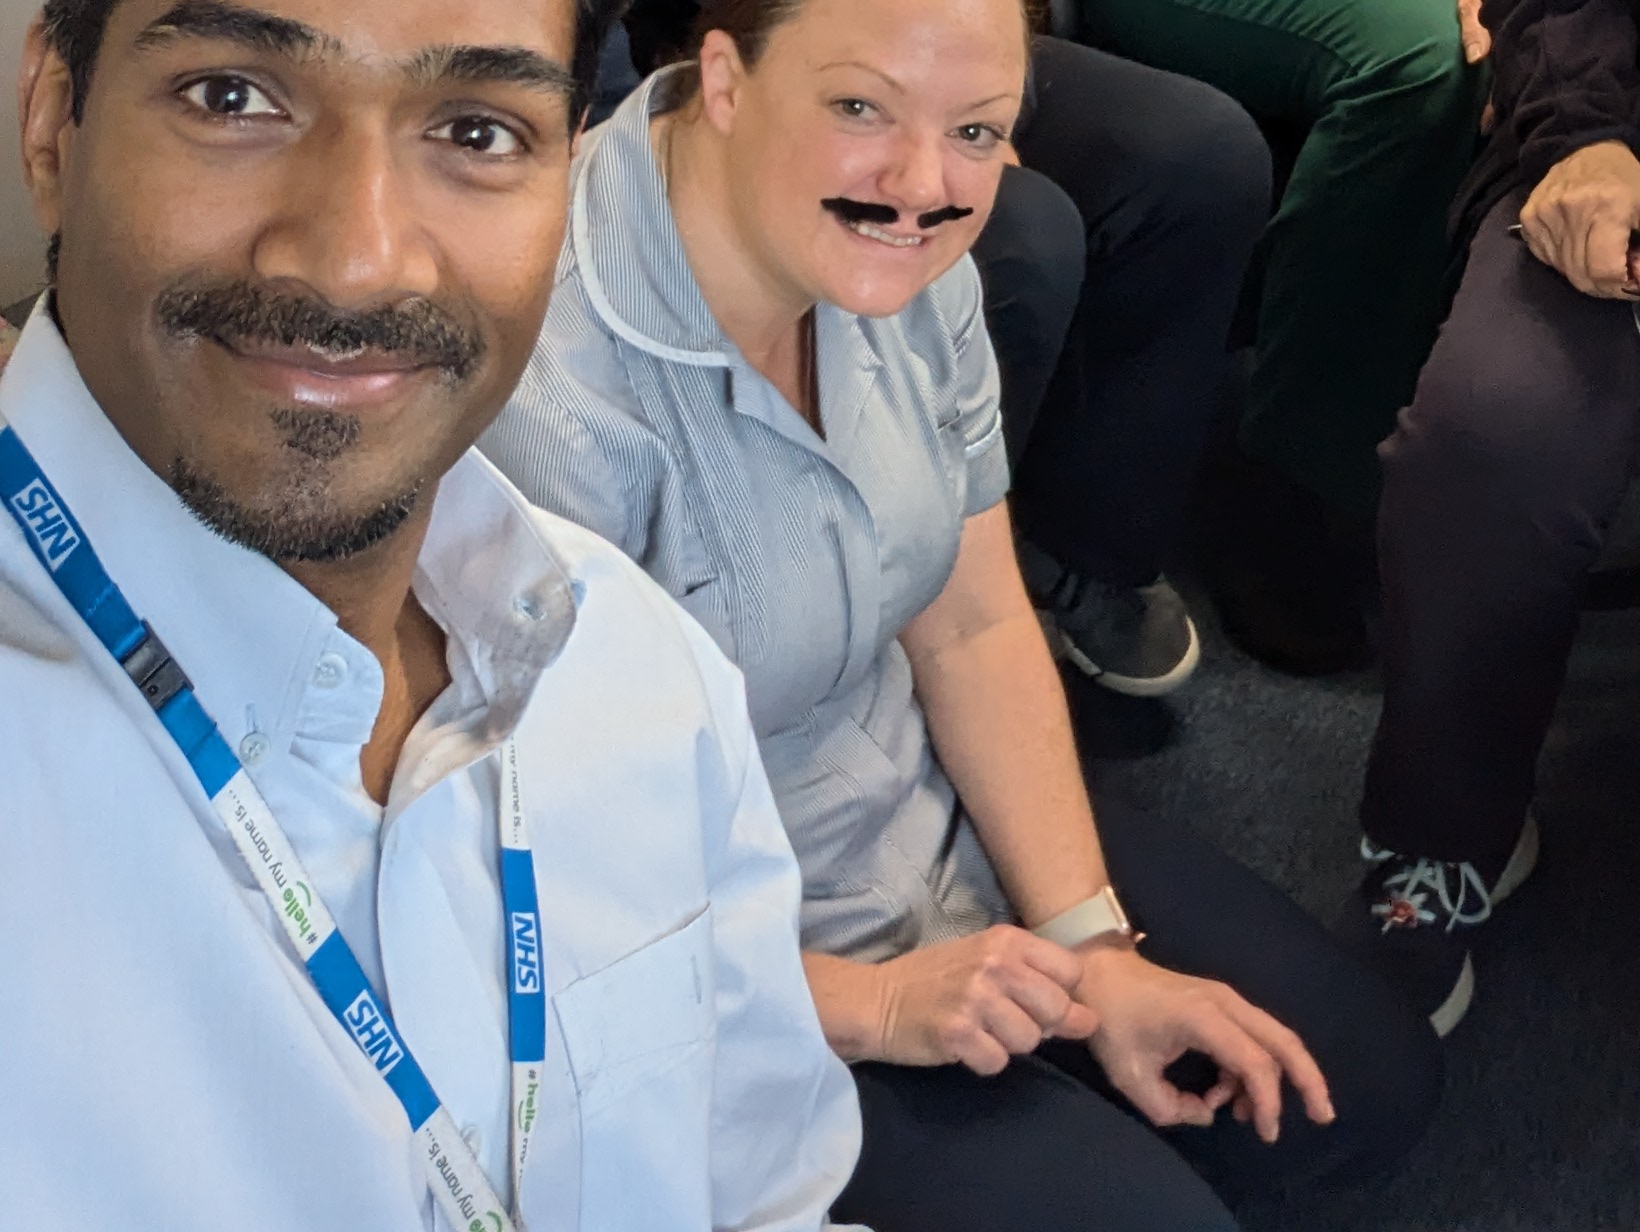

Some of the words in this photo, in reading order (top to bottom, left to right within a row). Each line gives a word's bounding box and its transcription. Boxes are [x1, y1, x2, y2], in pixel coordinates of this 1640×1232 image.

[14, 485, 77, 562] NHS
[511, 770, 520, 814] name
[244, 818, 272, 864] name
[269, 862, 287, 888] my
[515, 914, 538, 989] NHS
[346, 998, 400, 1072] NHS
[436, 1154, 463, 1197] name
[457, 1194, 476, 1220] my
